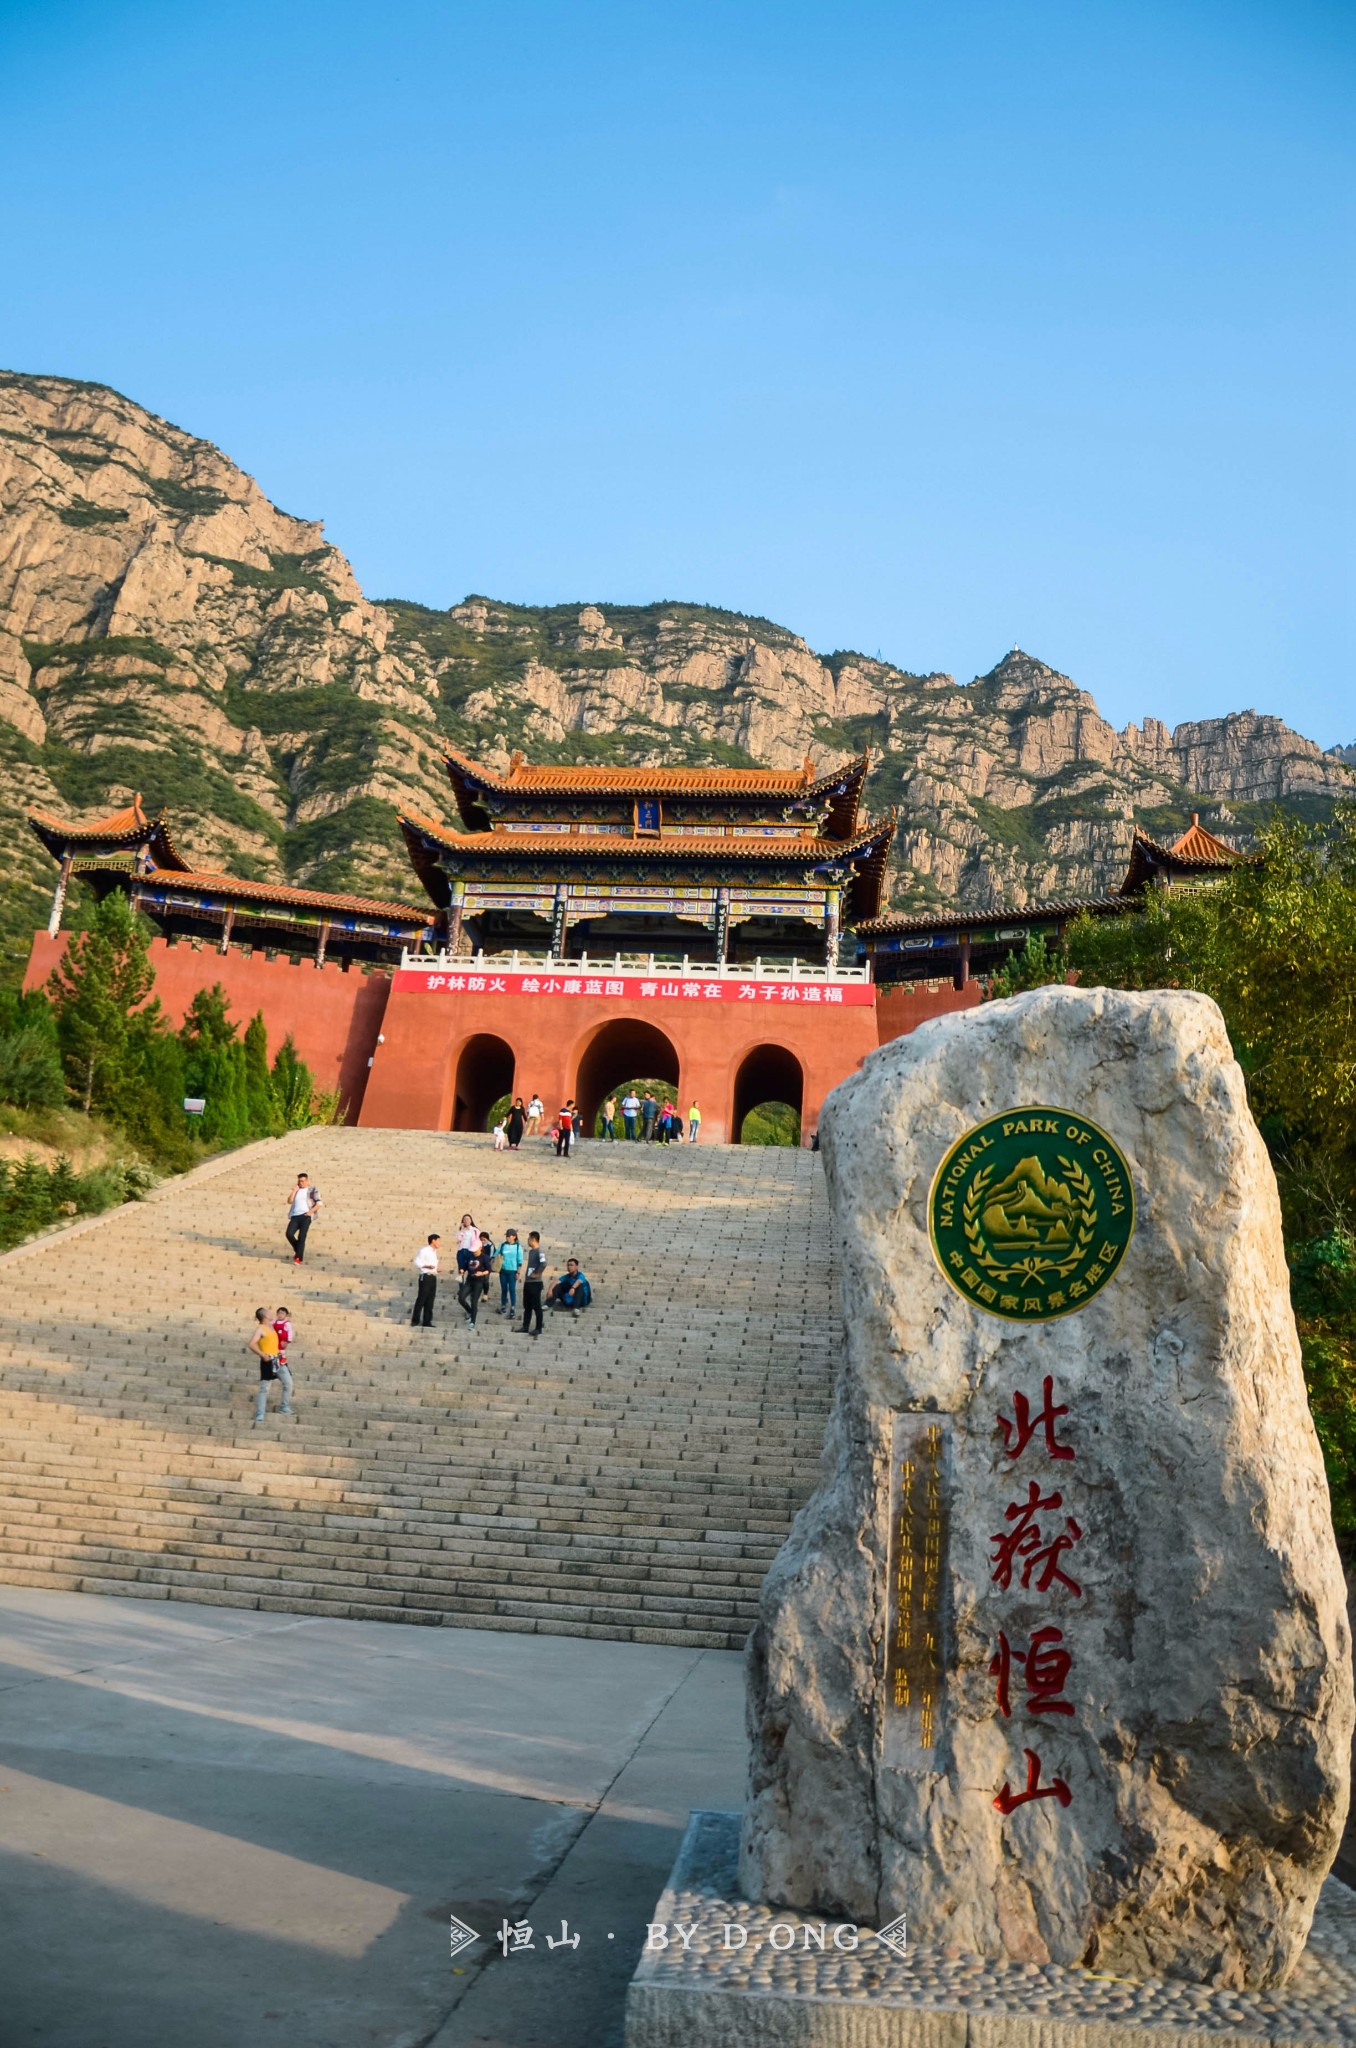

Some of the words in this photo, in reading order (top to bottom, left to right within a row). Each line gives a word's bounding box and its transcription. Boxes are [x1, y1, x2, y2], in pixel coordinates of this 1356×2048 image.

[427, 975, 506, 991] 护林防火
[521, 978, 624, 995] 绘小康蓝图
[640, 982, 722, 998] 青山常在
[738, 985, 843, 1002] 为子孙造福
[940, 1134, 995, 1228] NATIONAL
[1002, 1119, 1060, 1137] PARK
[1065, 1126, 1092, 1146] OF
[1092, 1148, 1126, 1217] CHINA
